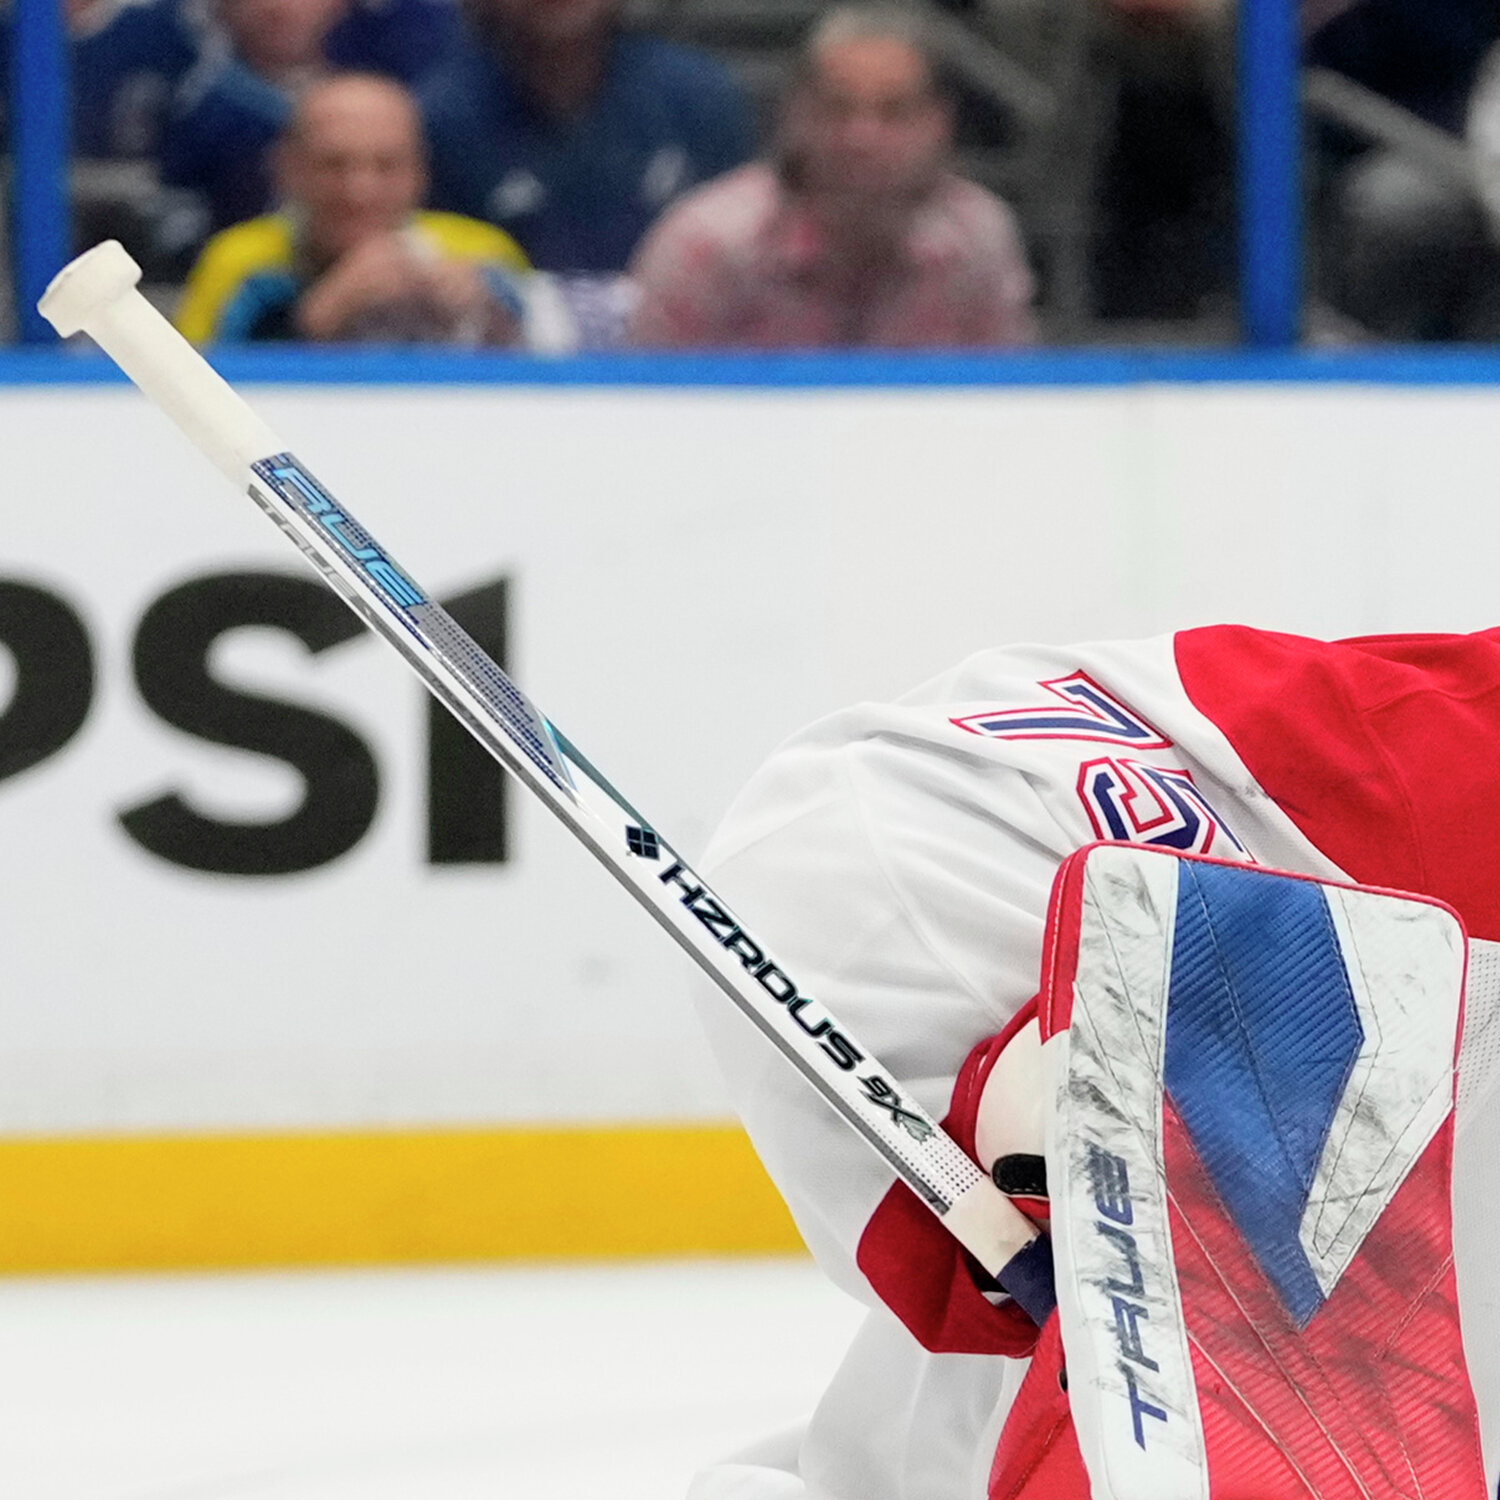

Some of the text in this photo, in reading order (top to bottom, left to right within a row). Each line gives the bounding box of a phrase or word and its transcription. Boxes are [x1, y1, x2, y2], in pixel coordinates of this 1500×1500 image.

[272, 454, 427, 608] RUE
[658, 863, 866, 1073] HZRDUS
[1086, 1140, 1168, 1452] TRUE
